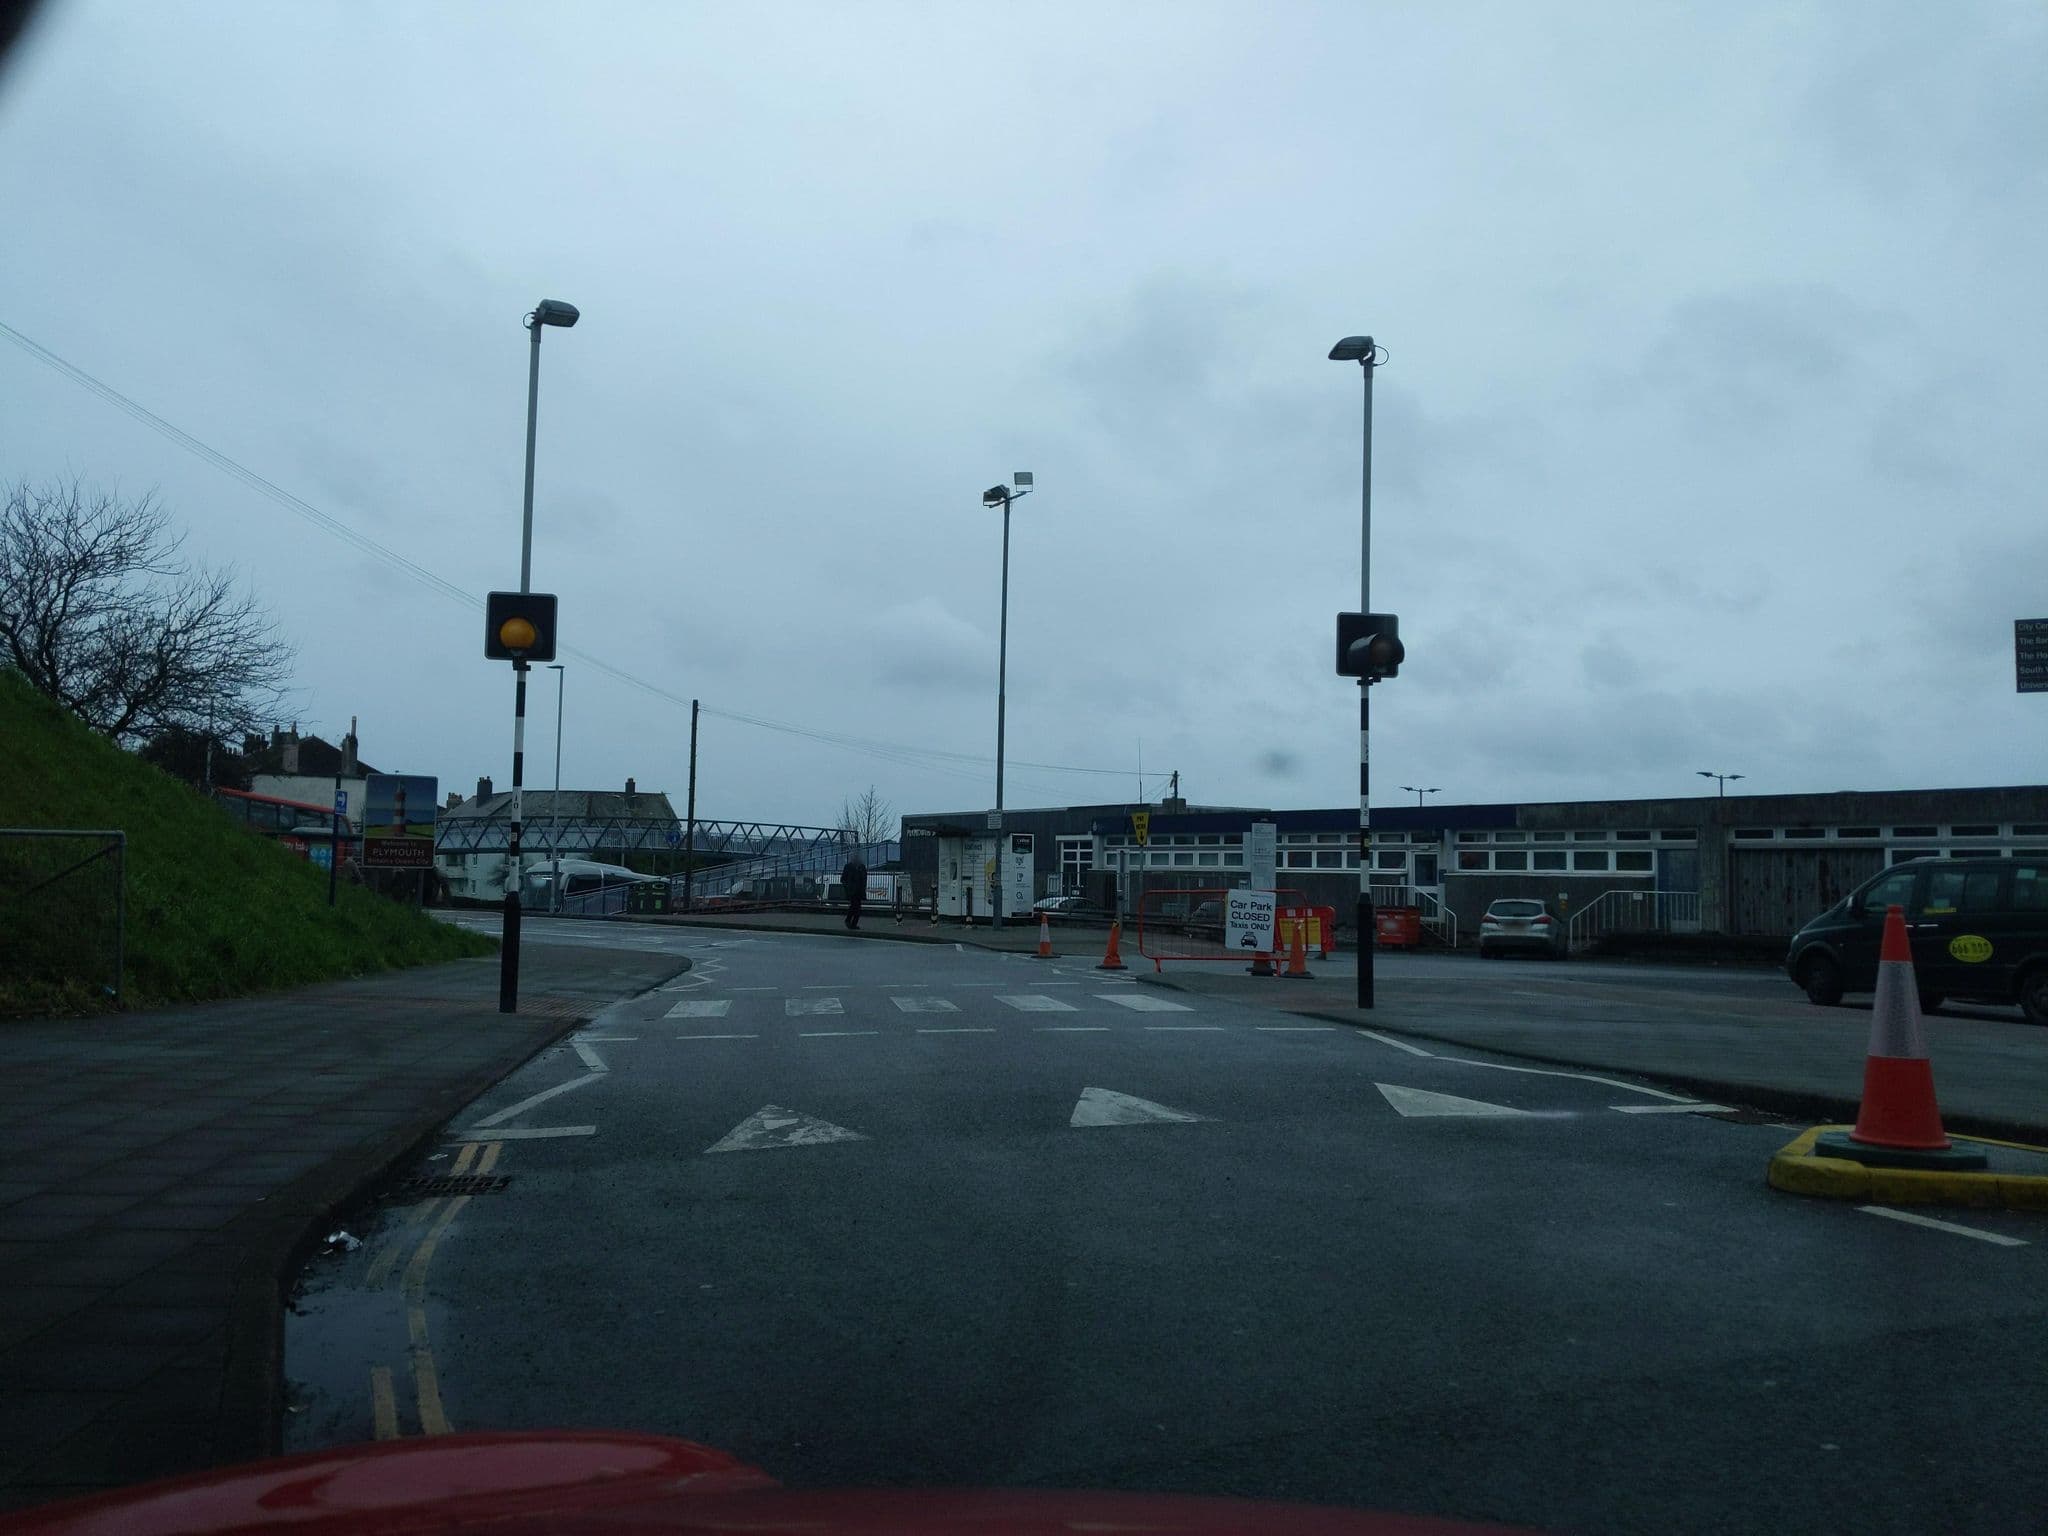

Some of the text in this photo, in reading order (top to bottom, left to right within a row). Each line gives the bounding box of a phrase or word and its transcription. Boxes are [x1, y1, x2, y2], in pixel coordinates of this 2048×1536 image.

[2018, 623, 2033, 632] City
[2020, 637, 2033, 645] The
[2020, 651, 2034, 660] The
[2020, 665, 2043, 674] South
[372, 847, 425, 857] PLYMOUTH
[1230, 899, 1273, 912] Car Park
[1231, 911, 1271, 922] CLOSED
[1230, 920, 1271, 931] Taxis ONLY
